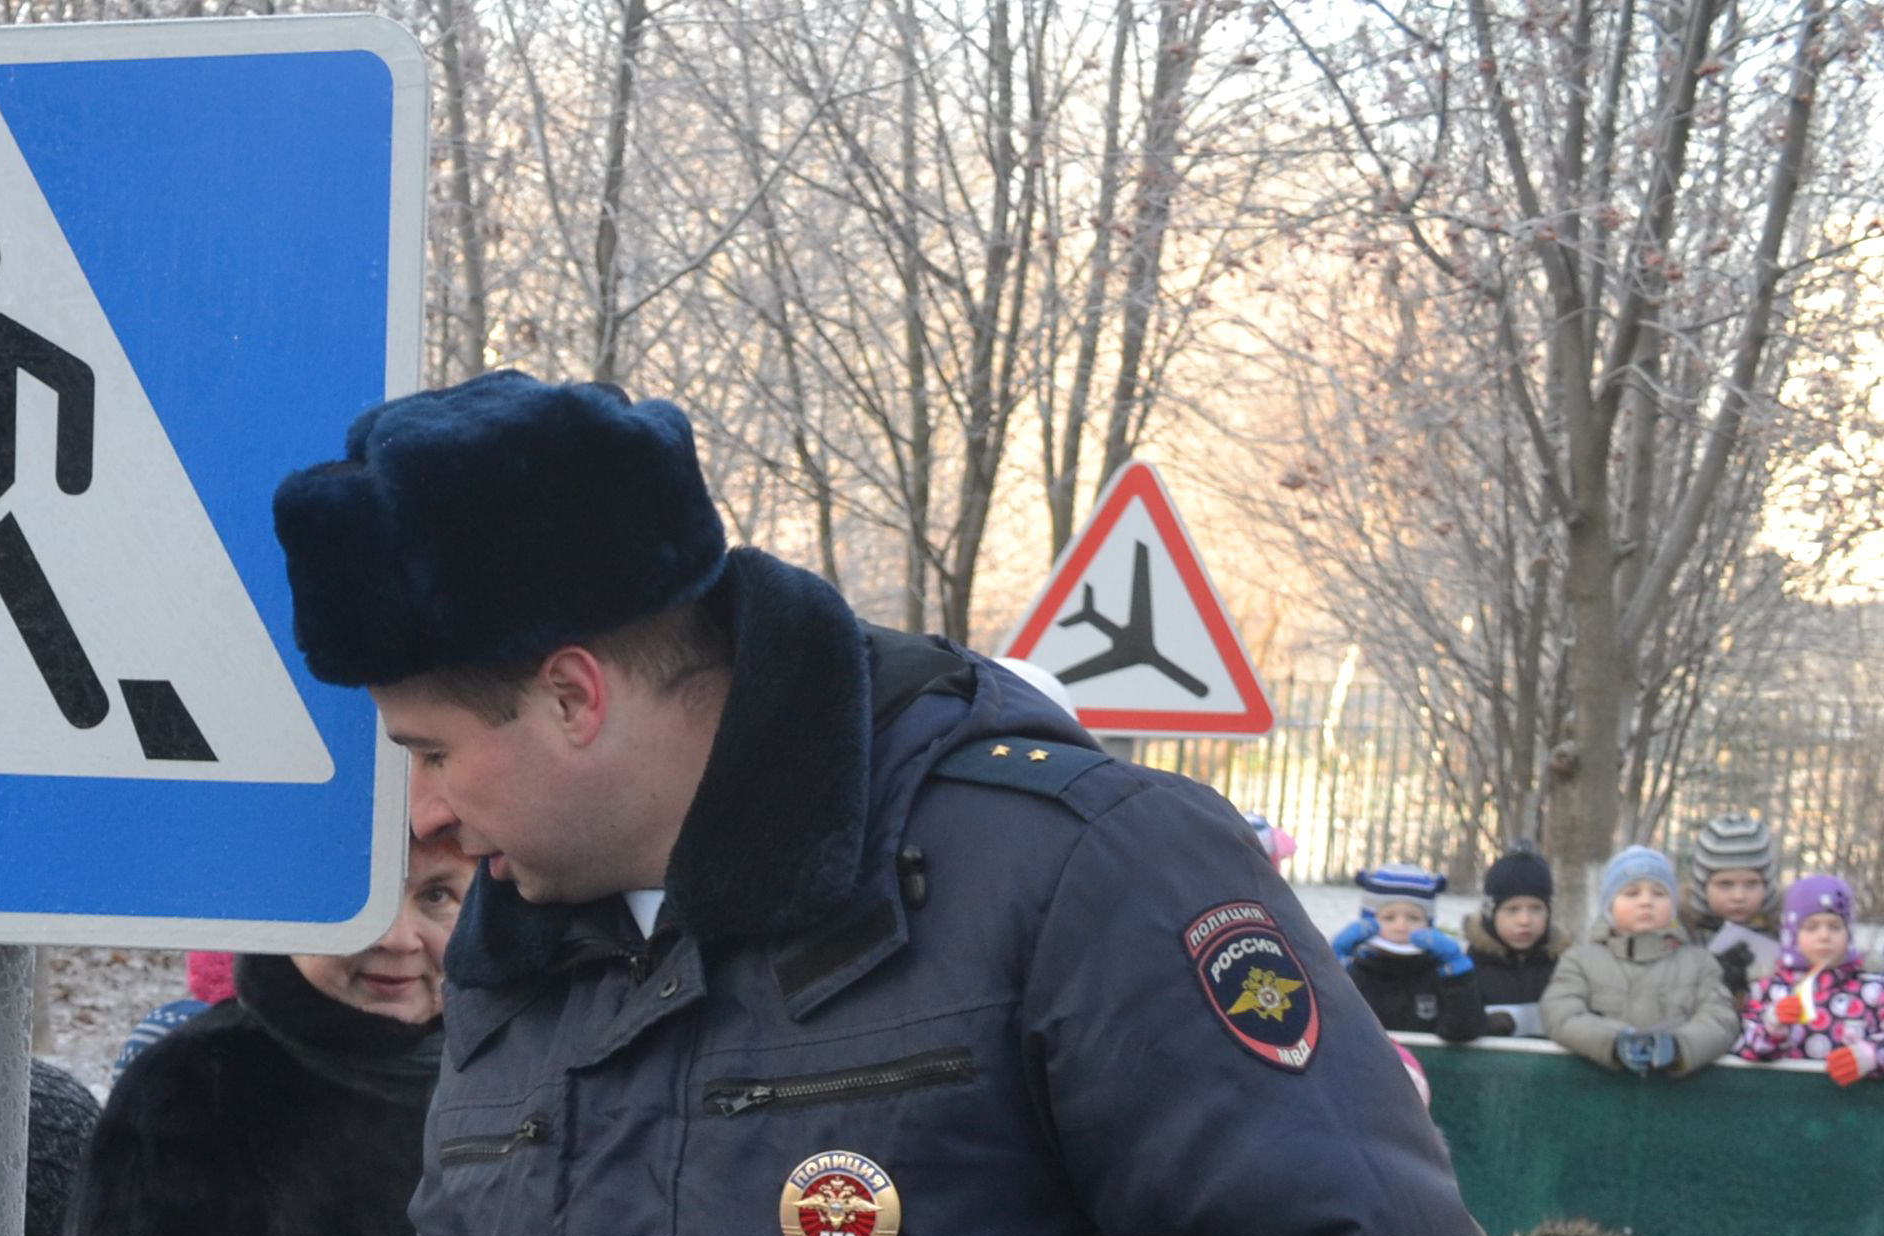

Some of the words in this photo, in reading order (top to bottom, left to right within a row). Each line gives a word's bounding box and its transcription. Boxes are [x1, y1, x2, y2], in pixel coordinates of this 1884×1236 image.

[1190, 907, 1265, 946] ПОЛИЦИЯ
[1210, 937, 1283, 983] РОССИЯ
[1277, 1038, 1312, 1067] МВД
[794, 1155, 886, 1189] ПОЛИЦИЯ
